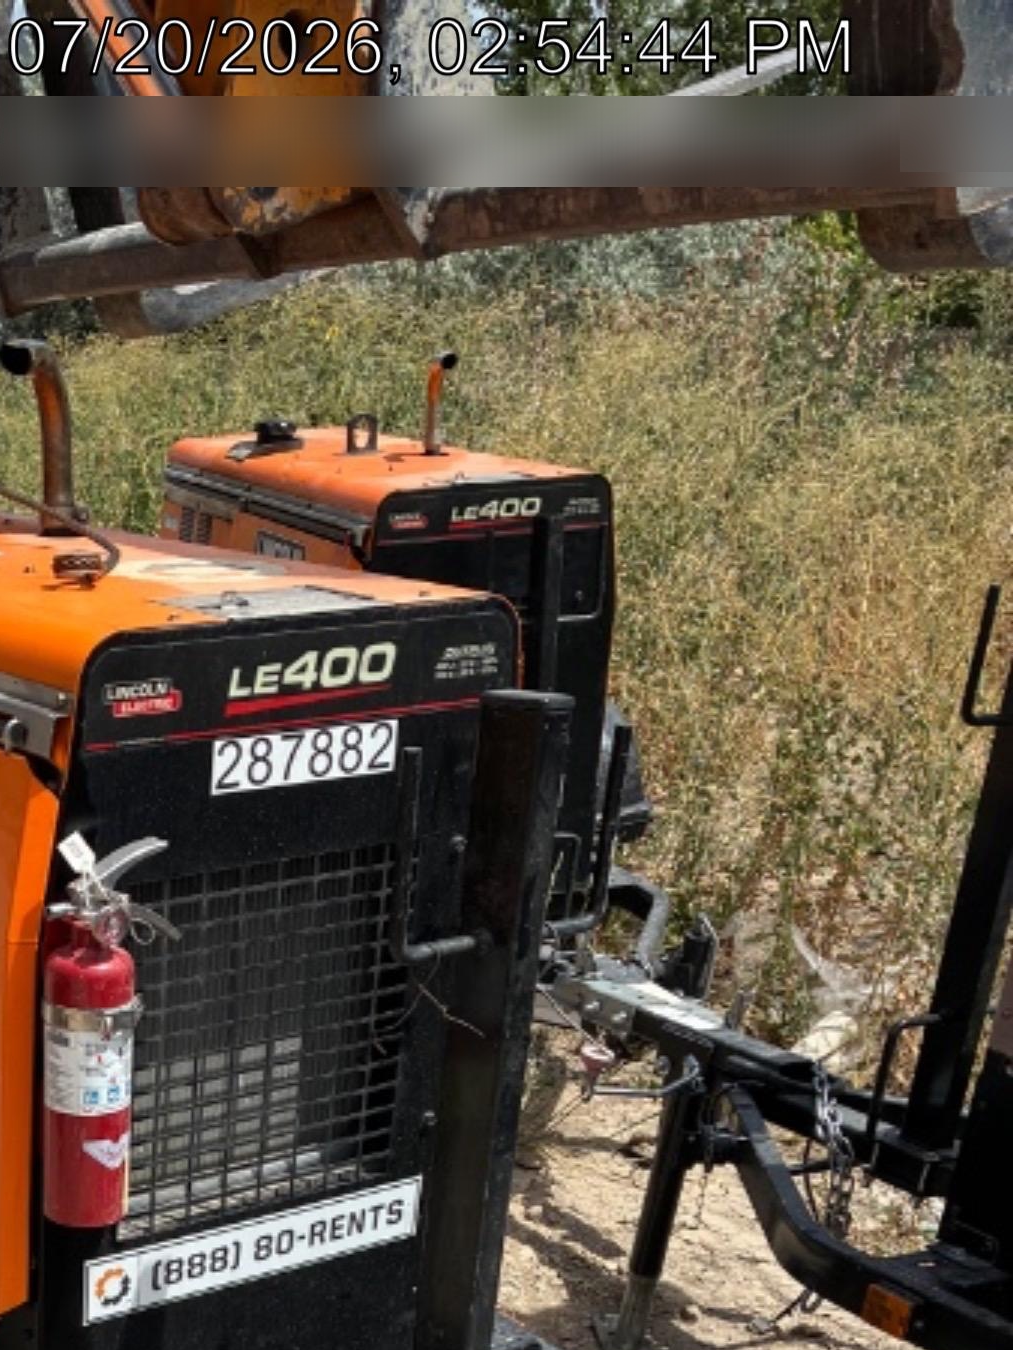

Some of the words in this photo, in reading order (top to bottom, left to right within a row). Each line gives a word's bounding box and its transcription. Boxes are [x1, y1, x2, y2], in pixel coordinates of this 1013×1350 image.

[451, 498, 542, 521] LE400
[228, 642, 397, 698] LE400
[214, 722, 394, 791] 287882
[152, 1241, 242, 1290] (888)
[254, 1199, 405, 1261] 80-RENTS
